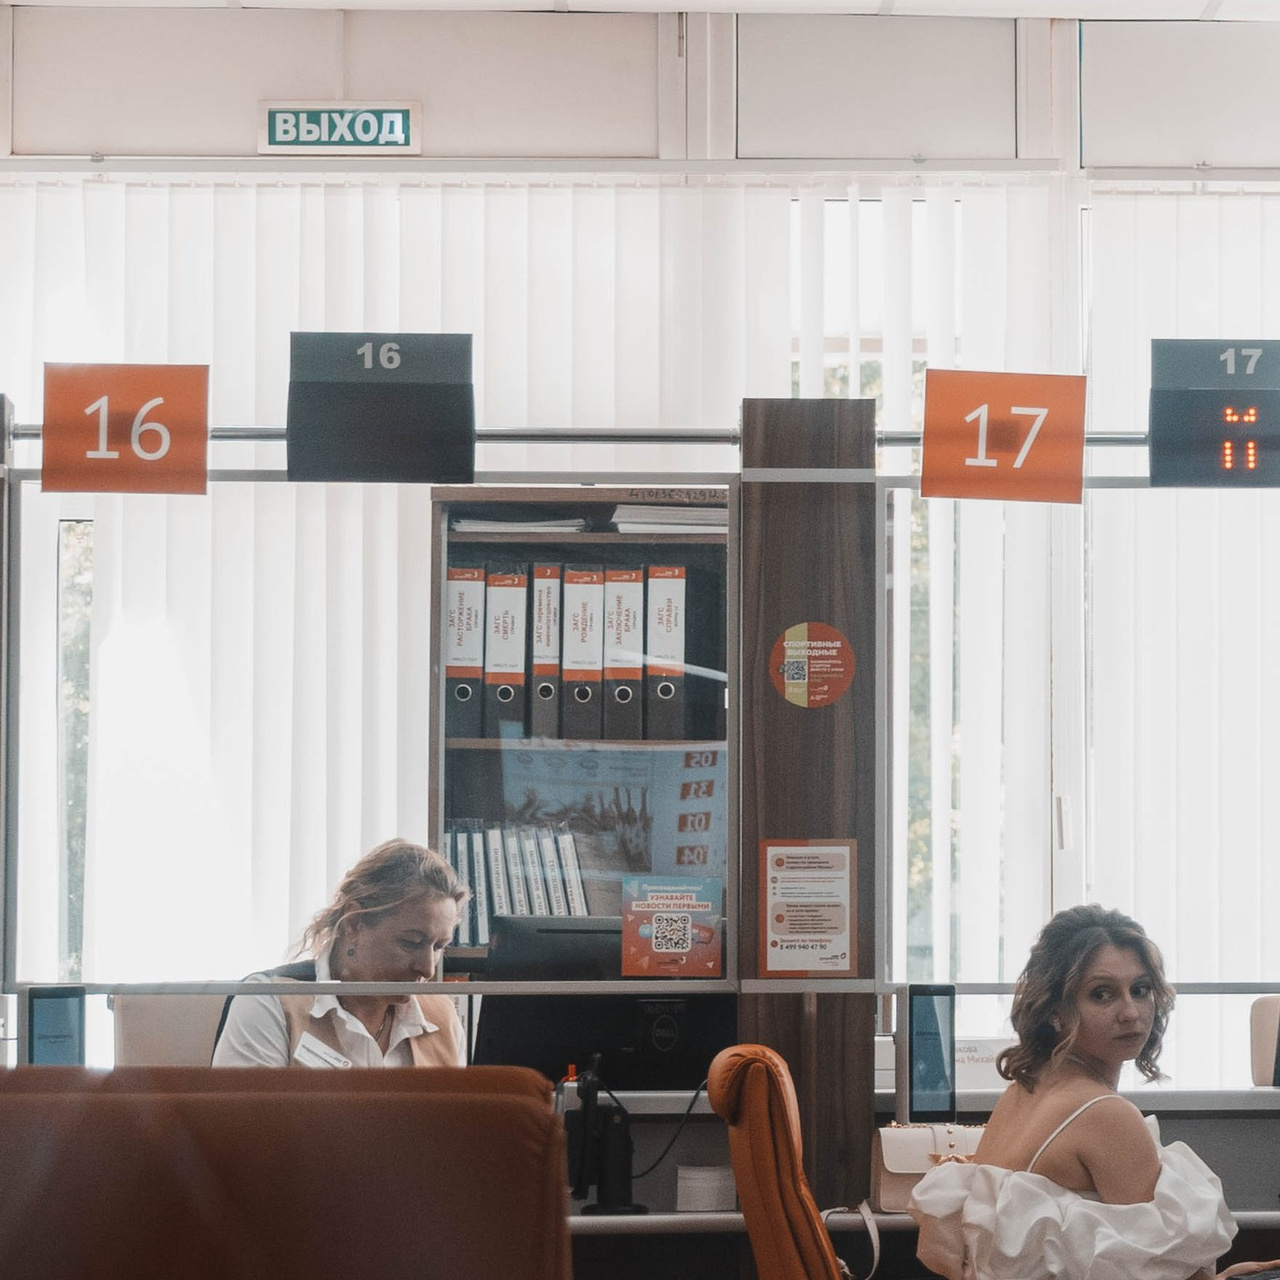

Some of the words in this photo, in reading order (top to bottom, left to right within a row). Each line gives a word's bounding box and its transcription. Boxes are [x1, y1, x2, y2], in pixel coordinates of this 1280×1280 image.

[275, 112, 405, 144] ВЫХОД
[356, 342, 401, 369] 16
[1219, 348, 1263, 375] 17
[84, 395, 171, 461] 16
[964, 404, 1049, 468] 17
[457, 591, 465, 647] РАСТОРЖЕНИЕ
